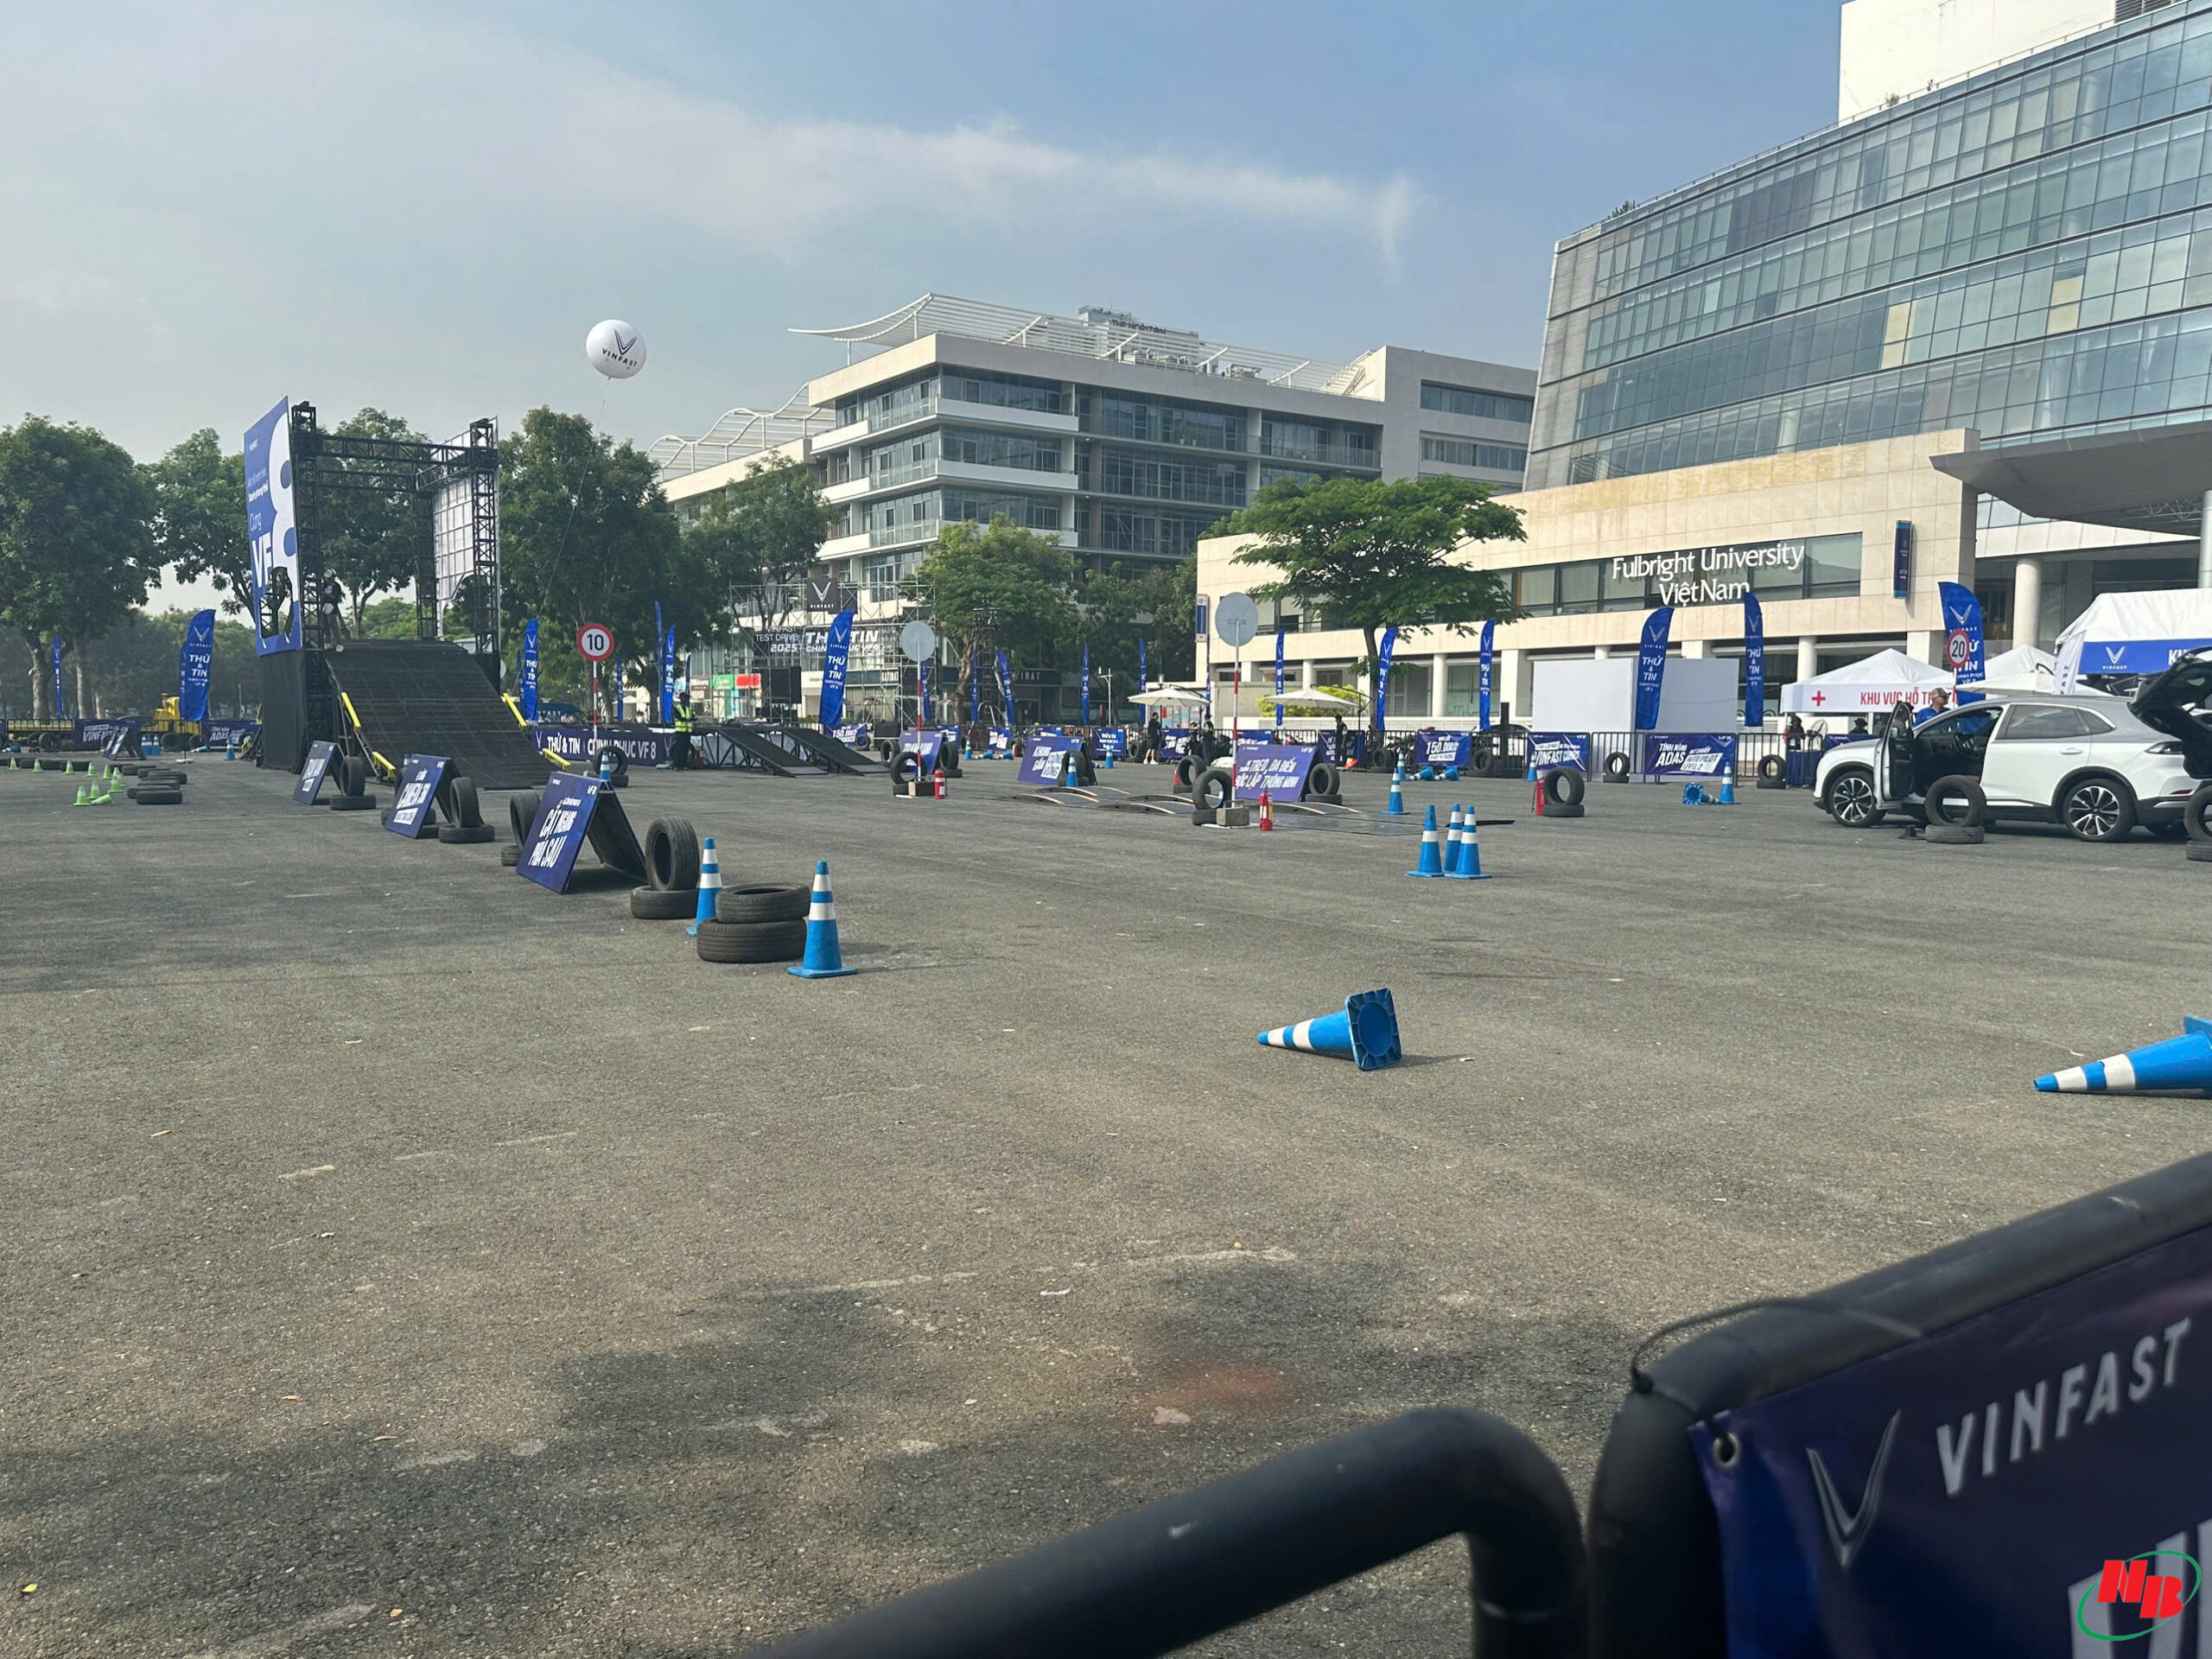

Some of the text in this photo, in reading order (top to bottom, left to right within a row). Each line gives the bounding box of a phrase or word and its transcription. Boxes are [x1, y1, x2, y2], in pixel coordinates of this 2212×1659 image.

[602, 347, 638, 366] VINFAST
[251, 531, 273, 588] VF
[1612, 543, 1805, 582] Fulbright University
[1658, 578, 1751, 607] Việt Nam
[587, 633, 604, 651] 10
[755, 633, 775, 642] TEST
[771, 644, 798, 652] 2025
[1951, 639, 1966, 658] 20
[1642, 655, 1663, 666] THỬ
[1958, 661, 1978, 671] IN
[192, 669, 207, 677] TIN
[830, 671, 842, 680] TIN
[1643, 672, 1657, 681] TIN
[1860, 691, 1881, 705] KHU
[1883, 690, 1902, 708] VỰC
[1904, 687, 1919, 706] HỖ
[547, 732, 562, 753] THỬ
[563, 738, 568, 753] &
[569, 737, 581, 754] TIN
[638, 741, 650, 759] VF
[651, 741, 657, 760] 8
[1655, 752, 1686, 767] ADAS
[540, 836, 567, 868] SAU
[1936, 1316, 2190, 1497] VINFAST
